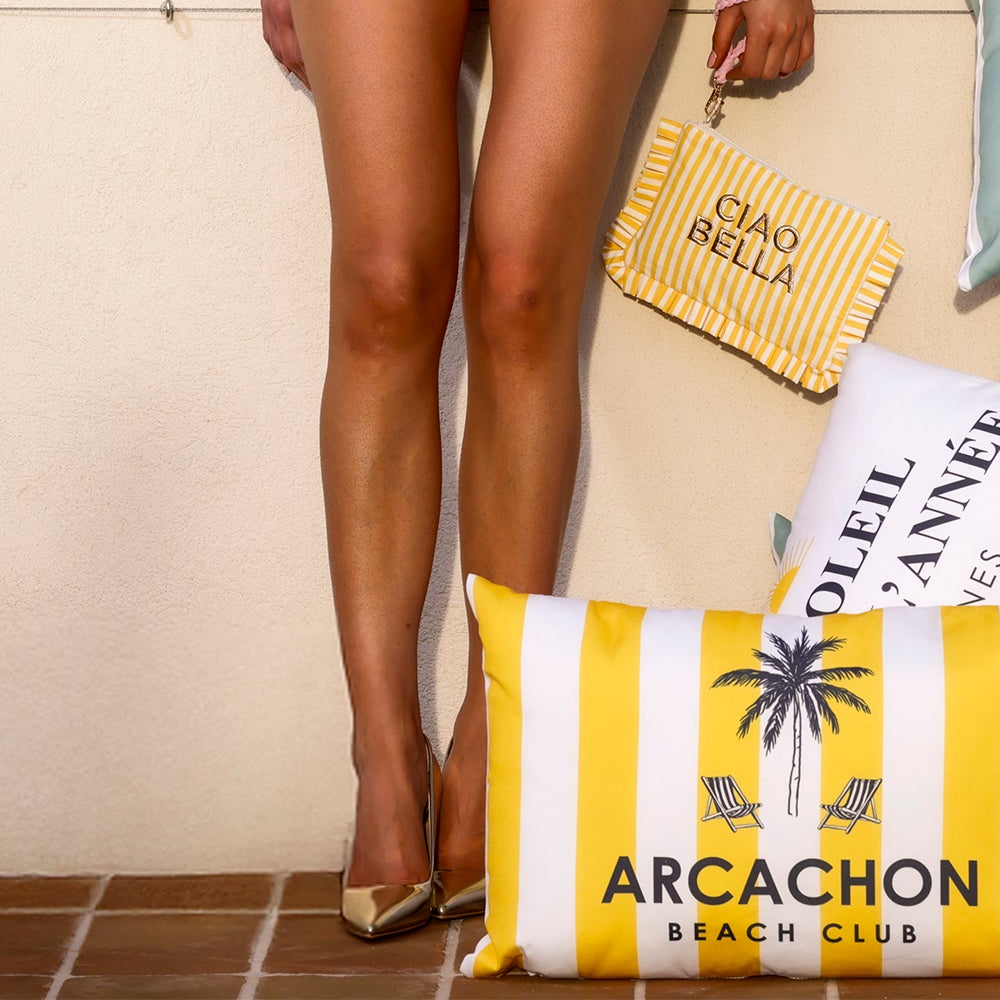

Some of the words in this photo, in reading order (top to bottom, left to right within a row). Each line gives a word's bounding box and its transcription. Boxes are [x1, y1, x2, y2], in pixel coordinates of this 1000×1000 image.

[715, 193, 801, 254] CIAO
[687, 214, 794, 295] BELLA
[601, 855, 979, 907] ARCACHON
[667, 922, 795, 943] BEACH
[821, 922, 917, 944] CLUB
